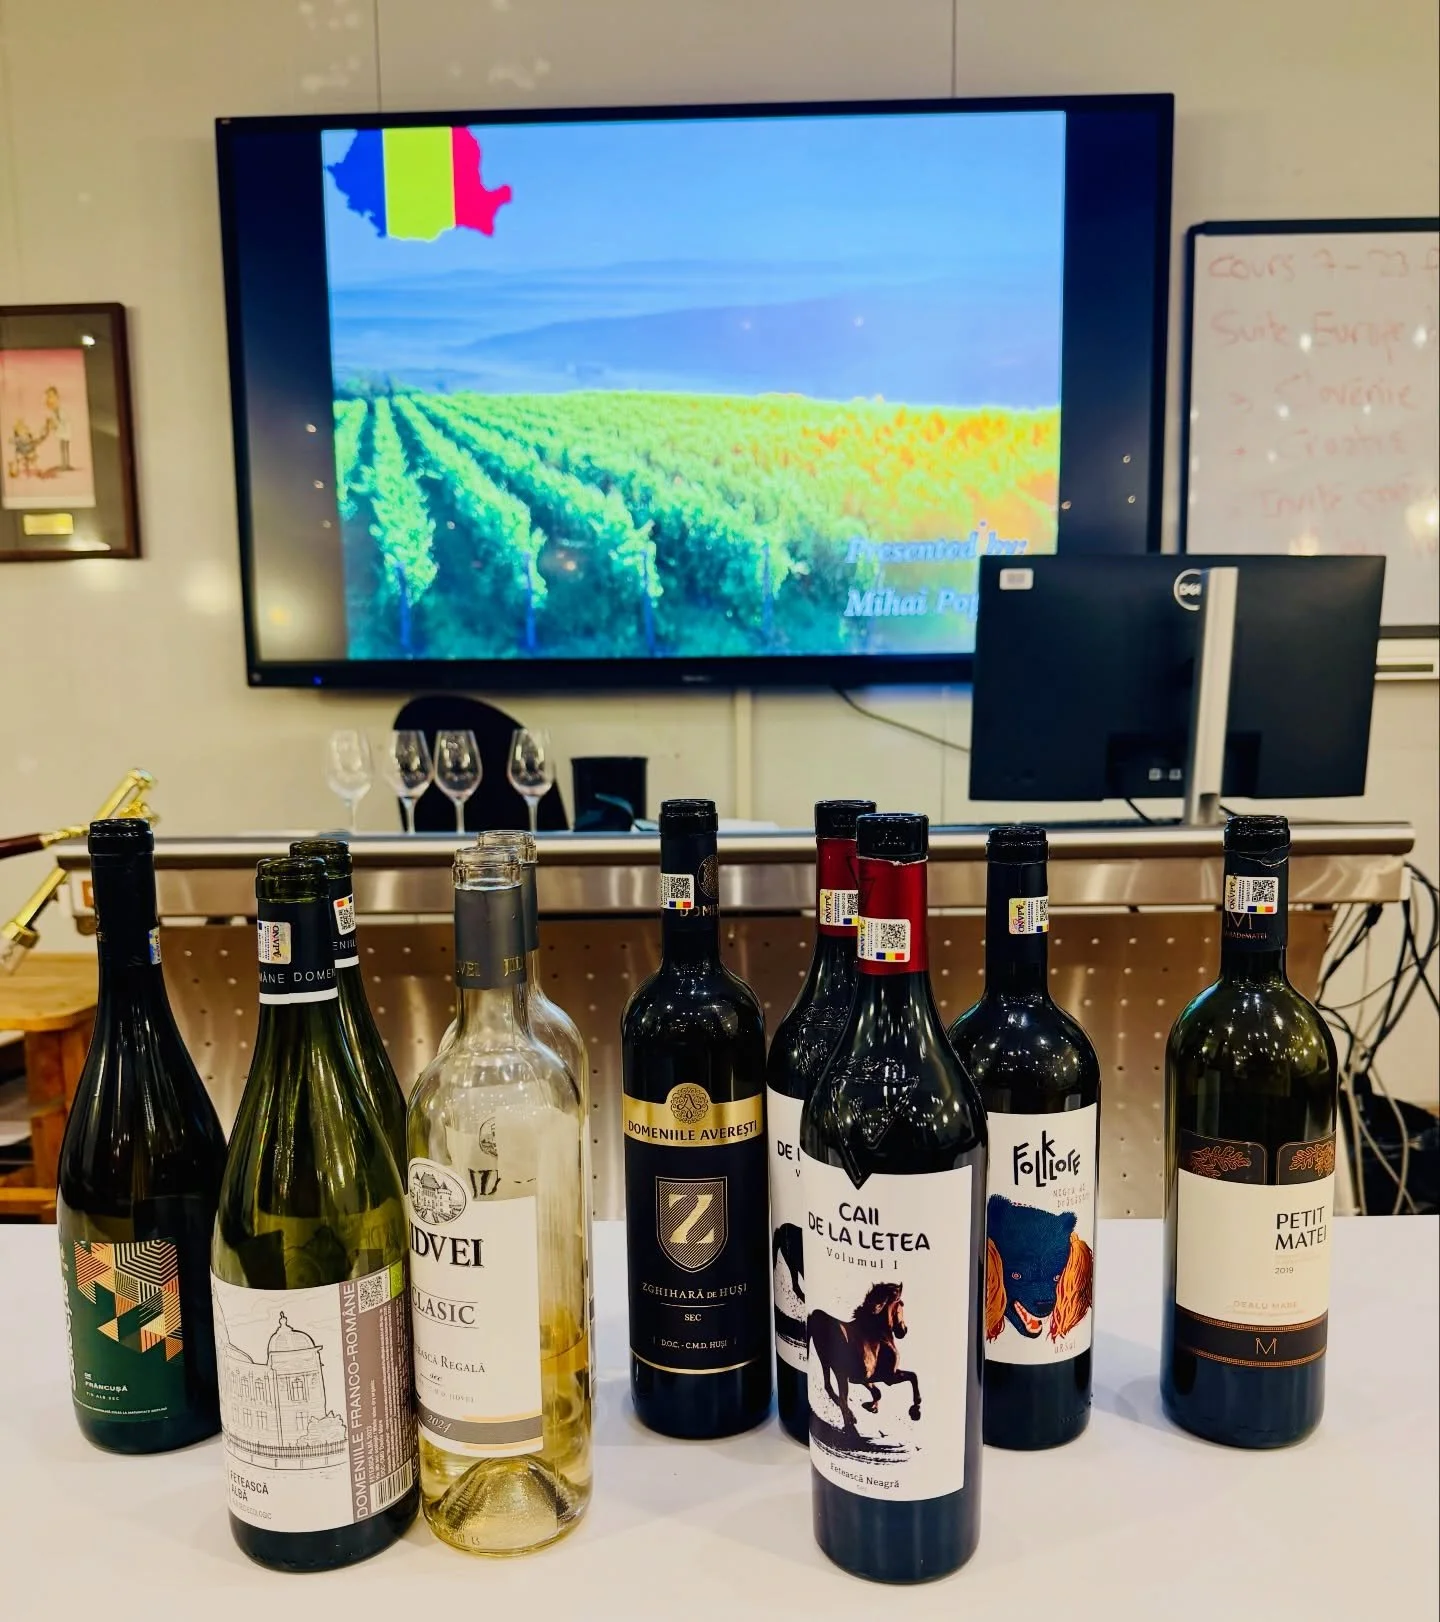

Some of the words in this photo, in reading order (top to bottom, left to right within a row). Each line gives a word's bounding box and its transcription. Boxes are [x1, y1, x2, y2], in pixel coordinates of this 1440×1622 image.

[844, 586, 928, 617] Mihai
[628, 1120, 695, 1140] DOMENIILE
[777, 1140, 792, 1160] DE
[668, 1194, 715, 1244] Z
[838, 1201, 879, 1225] CAII
[1276, 1206, 1325, 1230] PETIT
[808, 1211, 824, 1236] DE
[828, 1225, 852, 1246] LA
[859, 1232, 930, 1252] LETEA
[1275, 1225, 1327, 1250] MATEI
[826, 1246, 885, 1269] Volumul
[893, 1259, 899, 1270] I
[1274, 1266, 1294, 1275] 2019
[642, 1282, 704, 1299] ZGHIHARĂ
[707, 1291, 717, 1299] DE
[412, 1286, 475, 1325] CLASIC
[684, 1313, 702, 1322] SEC
[343, 1281, 363, 1429] FRANCO-ROMÂNE
[1255, 1337, 1277, 1355] M
[427, 1414, 453, 1433] 2024
[230, 1470, 269, 1495] FETEASCĂ
[351, 1431, 370, 1520] DOMENIILE
[830, 1462, 864, 1483] Fetească
[866, 1476, 900, 1490] Neagră
[232, 1483, 248, 1501] ALBĂ
